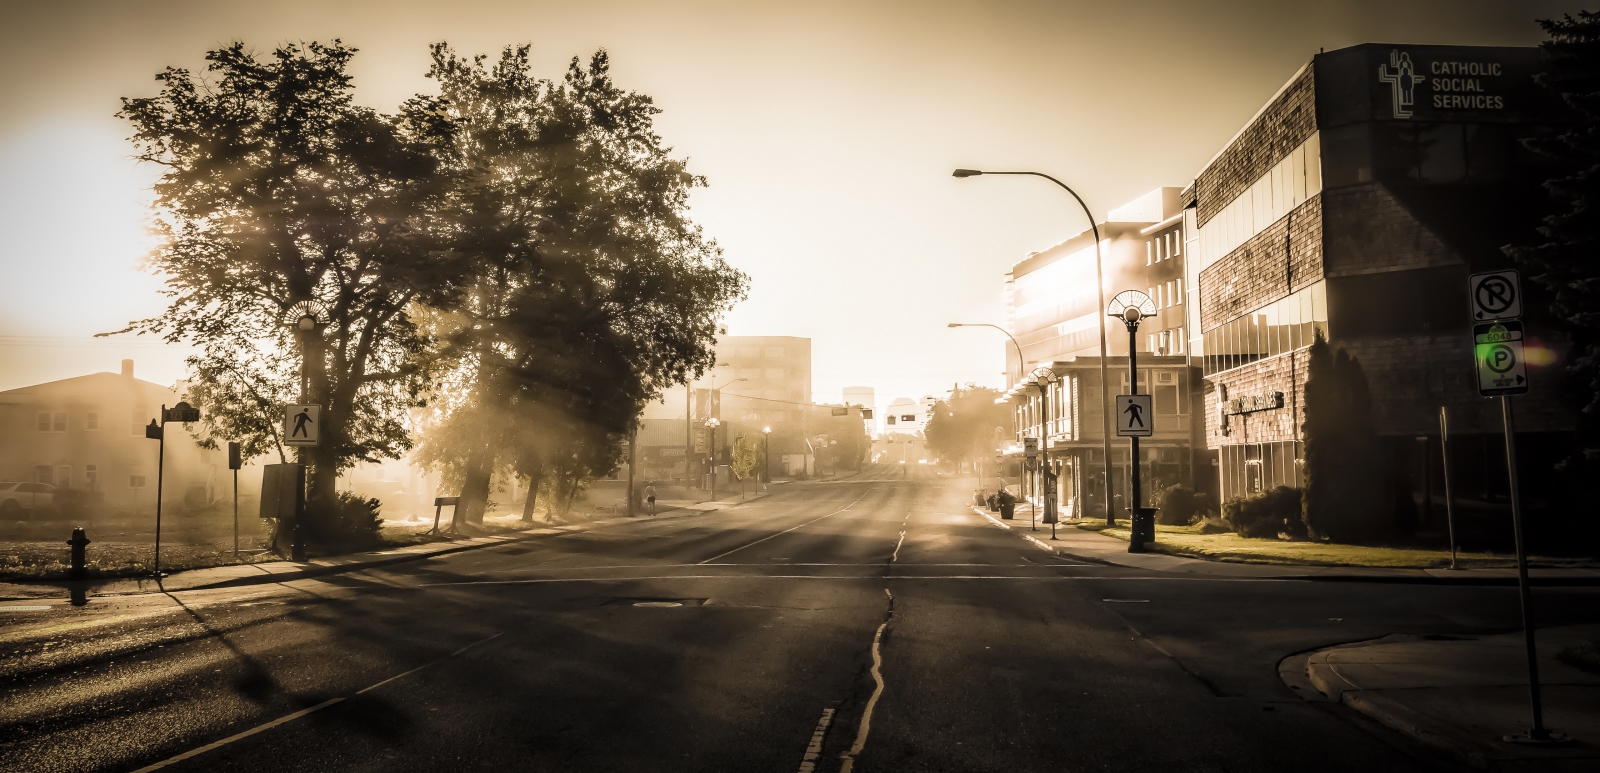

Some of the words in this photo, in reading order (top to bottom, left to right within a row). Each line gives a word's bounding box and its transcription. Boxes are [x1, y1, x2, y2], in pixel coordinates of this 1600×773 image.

[1431, 61, 1501, 76] CATHOLIC
[1432, 78, 1484, 92] SOCIAL
[1433, 94, 1503, 109] SERVICES
[1487, 332, 1512, 341] 6048
[1495, 351, 1508, 367] P
[170, 411, 183, 420] 125
